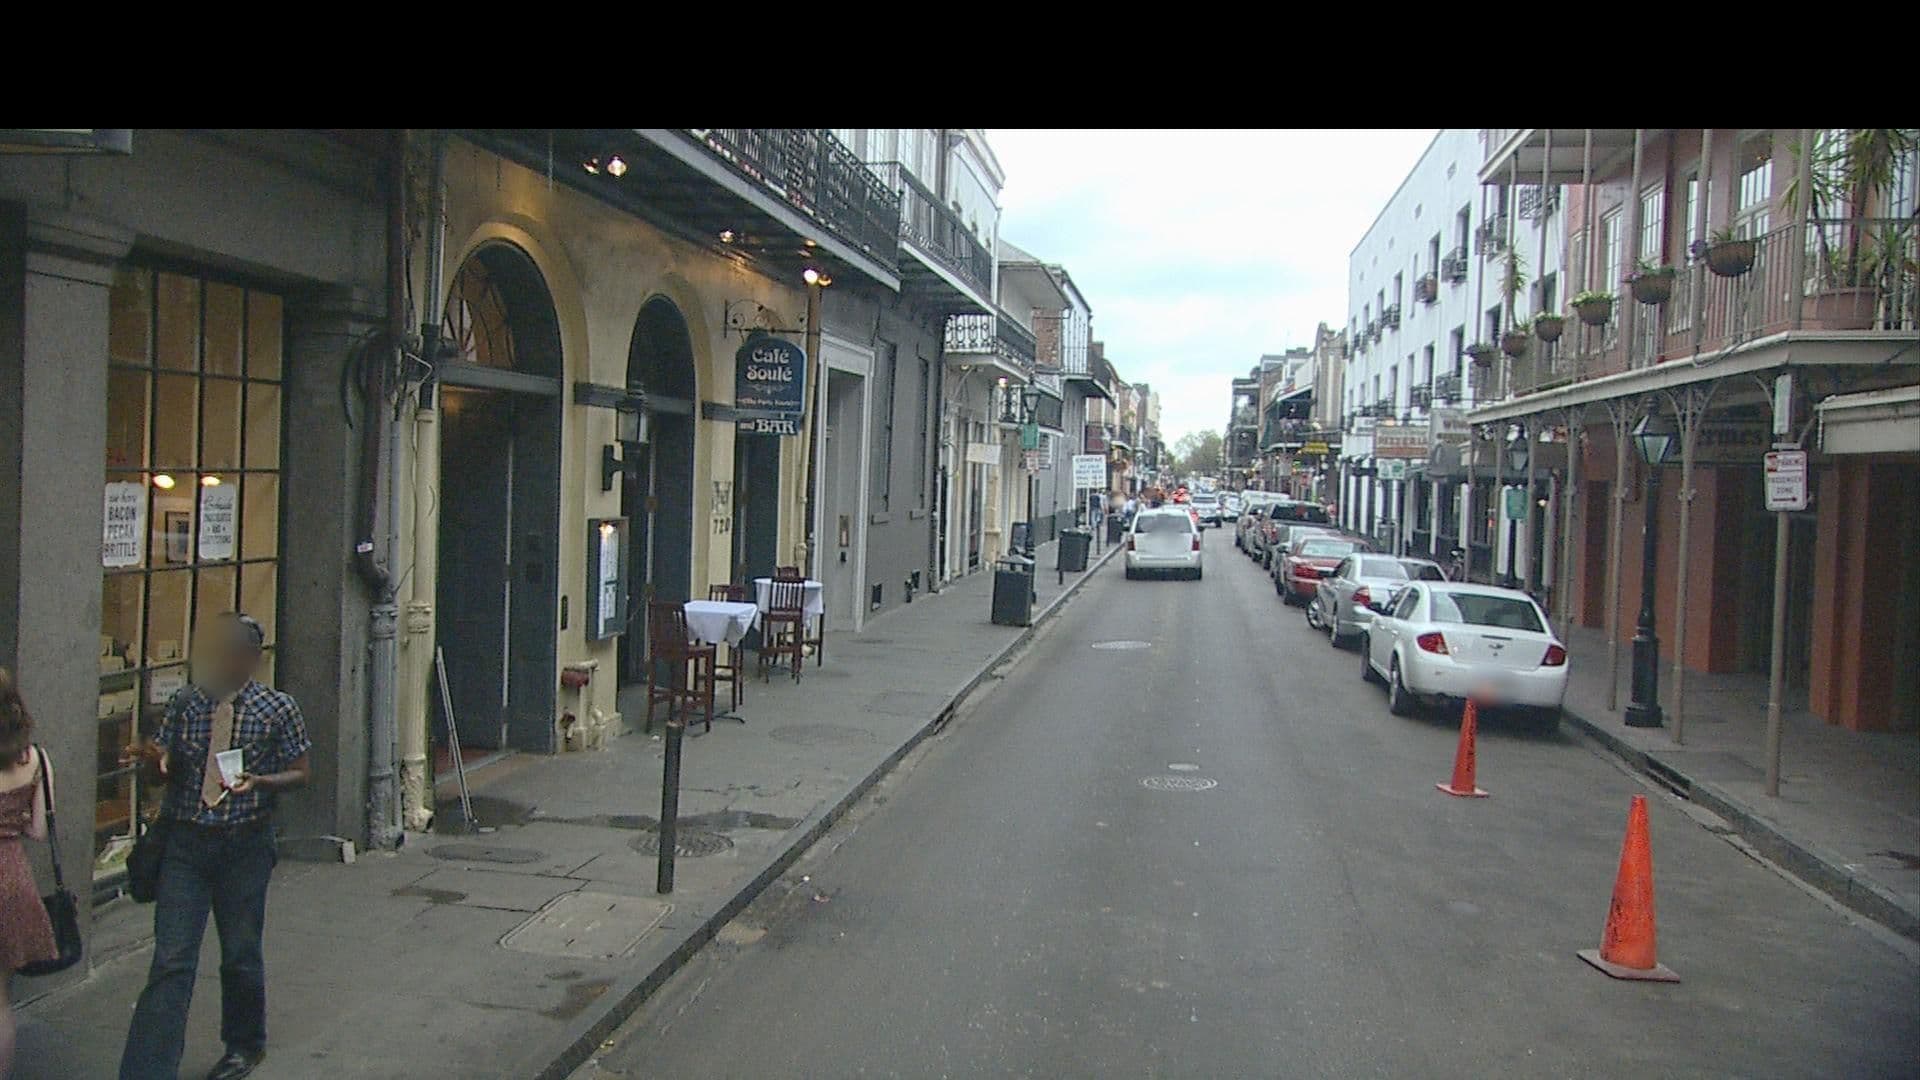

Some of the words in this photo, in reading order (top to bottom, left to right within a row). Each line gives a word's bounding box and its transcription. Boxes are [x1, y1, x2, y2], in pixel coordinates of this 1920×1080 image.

[752, 347, 790, 364] Café
[746, 365, 793, 382] Soulé
[756, 419, 796, 434] BAR
[108, 506, 137, 521] BACON
[107, 523, 136, 540] PECAN
[713, 517, 731, 535] 720
[103, 541, 137, 558] BRITTLE
